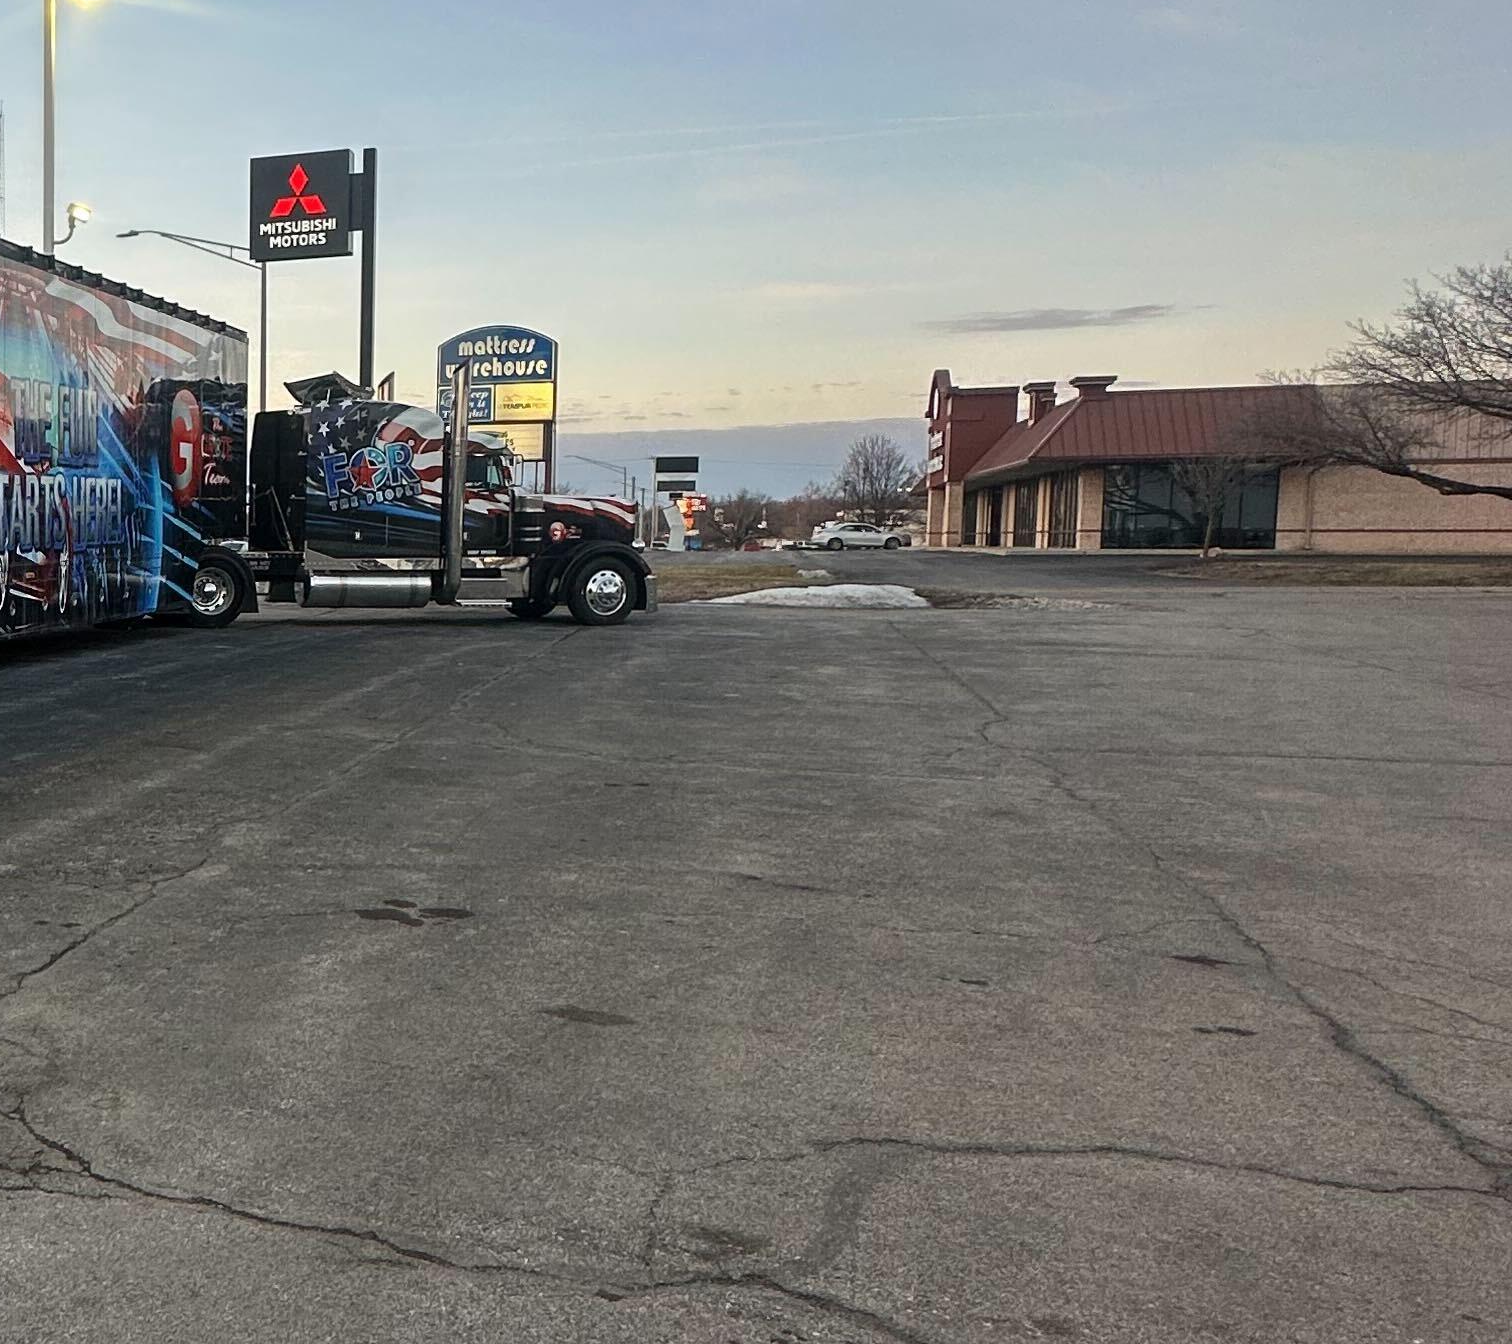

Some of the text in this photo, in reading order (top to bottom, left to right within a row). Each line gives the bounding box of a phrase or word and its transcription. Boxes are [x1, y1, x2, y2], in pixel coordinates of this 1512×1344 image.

[259, 218, 336, 235] MITSUBISHI
[269, 232, 326, 248] MOTORS
[458, 336, 535, 356] mattress
[445, 357, 548, 378] wrehouse
[329, 483, 422, 511] THE PEOPLE
